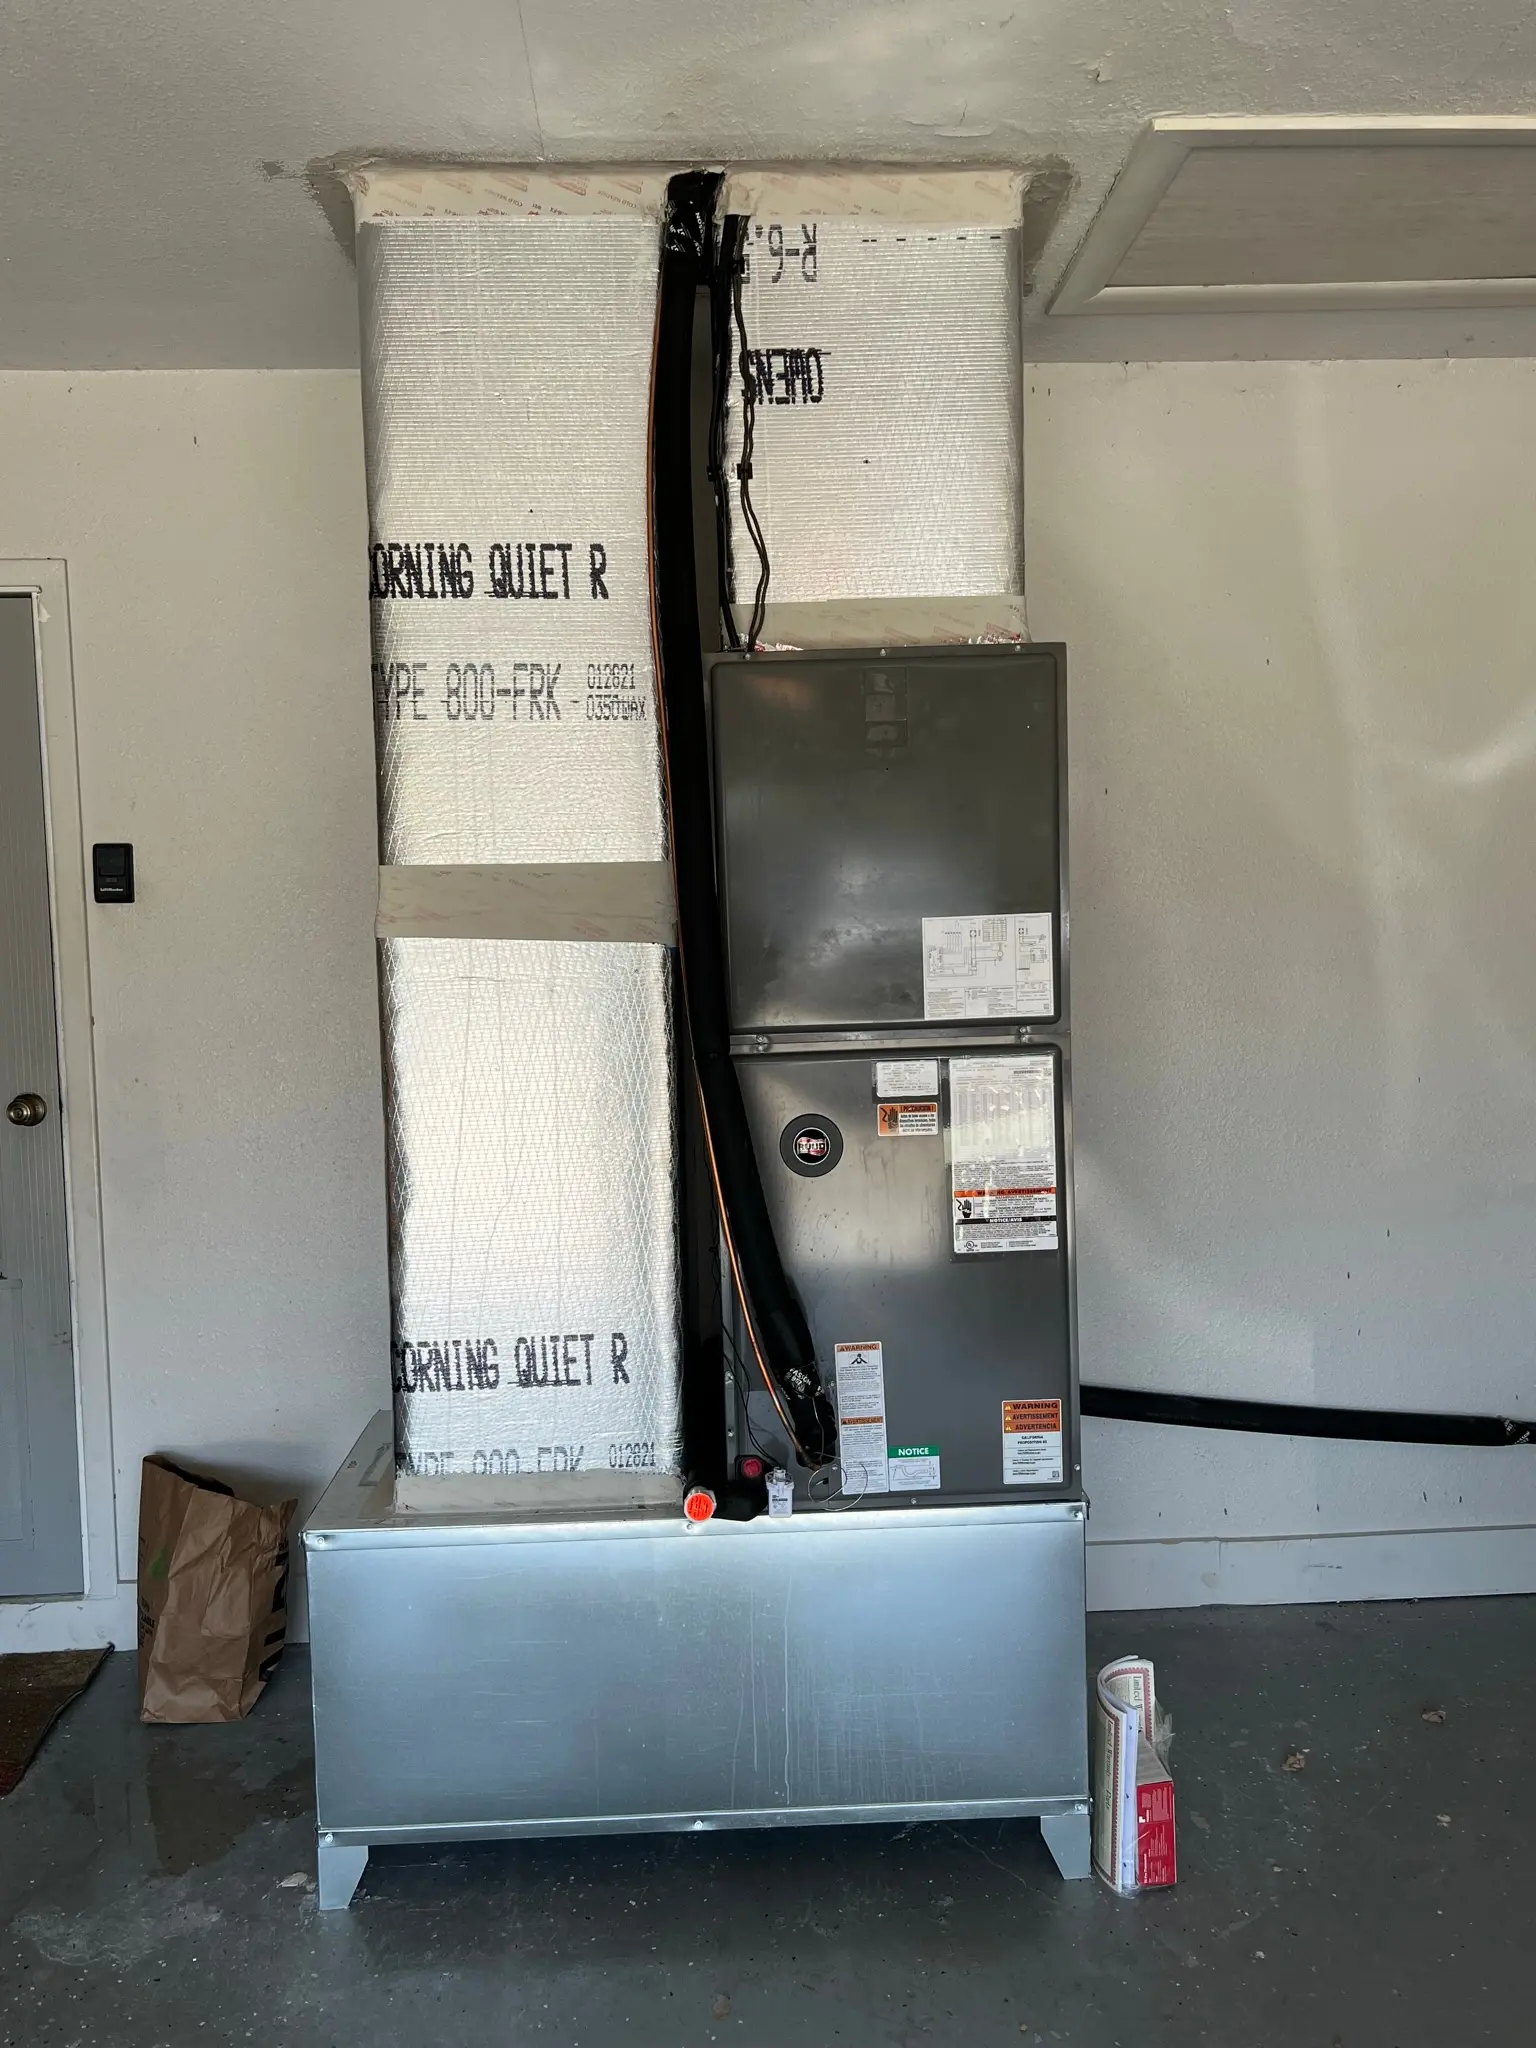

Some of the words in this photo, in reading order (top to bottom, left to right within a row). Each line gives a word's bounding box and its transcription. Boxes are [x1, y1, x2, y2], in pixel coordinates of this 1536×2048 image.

[739, 348, 824, 405] OWENS
[369, 543, 474, 599] ORNING
[488, 543, 573, 599] QUIET
[589, 543, 609, 599] R
[446, 663, 562, 720] 800-FRK
[844, 1343, 877, 1352] WARNING
[514, 1333, 595, 1388] QUIET
[611, 1332, 630, 1384] R
[1012, 1402, 1058, 1410] WARNING
[1012, 1412, 1058, 1420] AVERTISSEMENT
[1015, 1422, 1057, 1430] ADVERTENCIA
[897, 1447, 929, 1456] NOTICE
